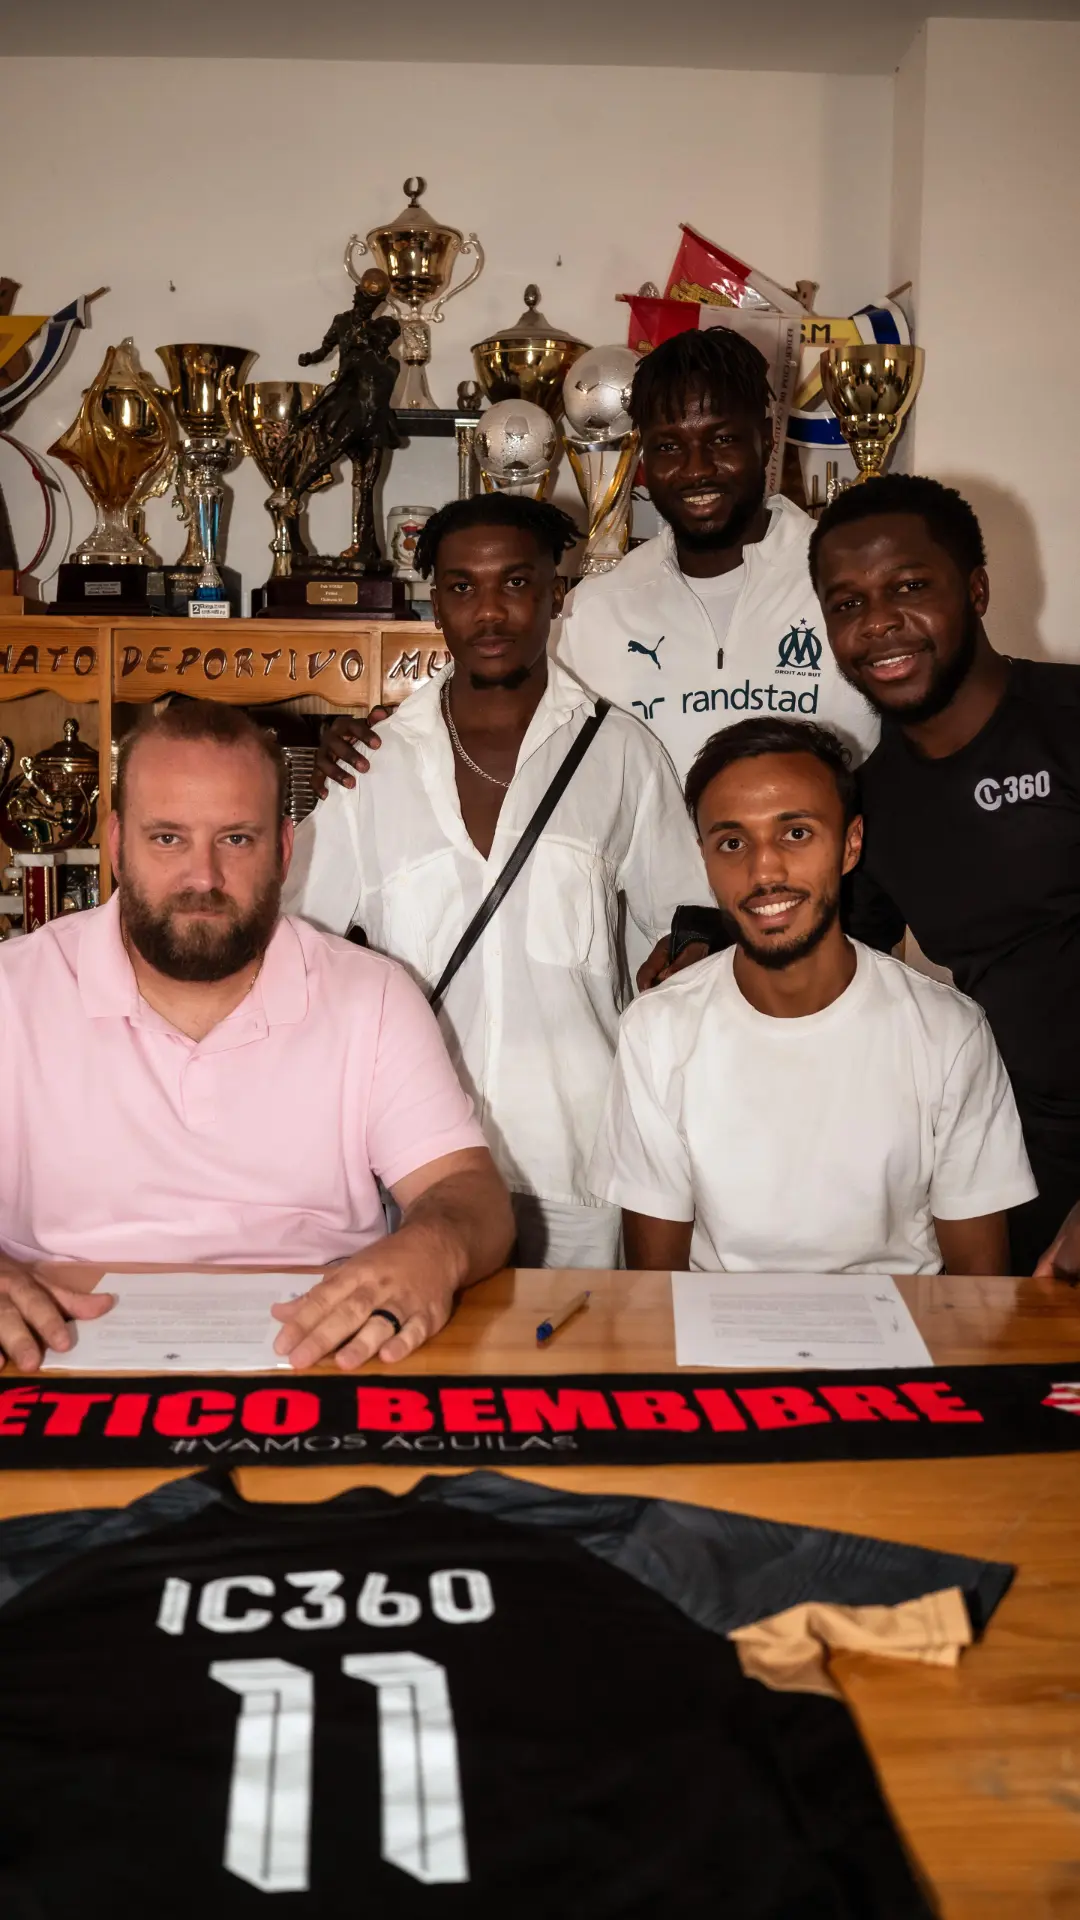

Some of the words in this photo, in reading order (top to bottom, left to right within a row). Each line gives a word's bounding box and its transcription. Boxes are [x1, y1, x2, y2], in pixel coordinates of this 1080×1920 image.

[121, 645, 364, 682] DEPORTIVO
[682, 679, 819, 714] randstad
[0, 1386, 320, 1437] ÉTICO
[357, 1382, 984, 1433] BEMBIBRE
[171, 1433, 367, 1454] #VAMOS
[156, 1569, 495, 1635] IC360
[208, 1651, 470, 1893] 11
